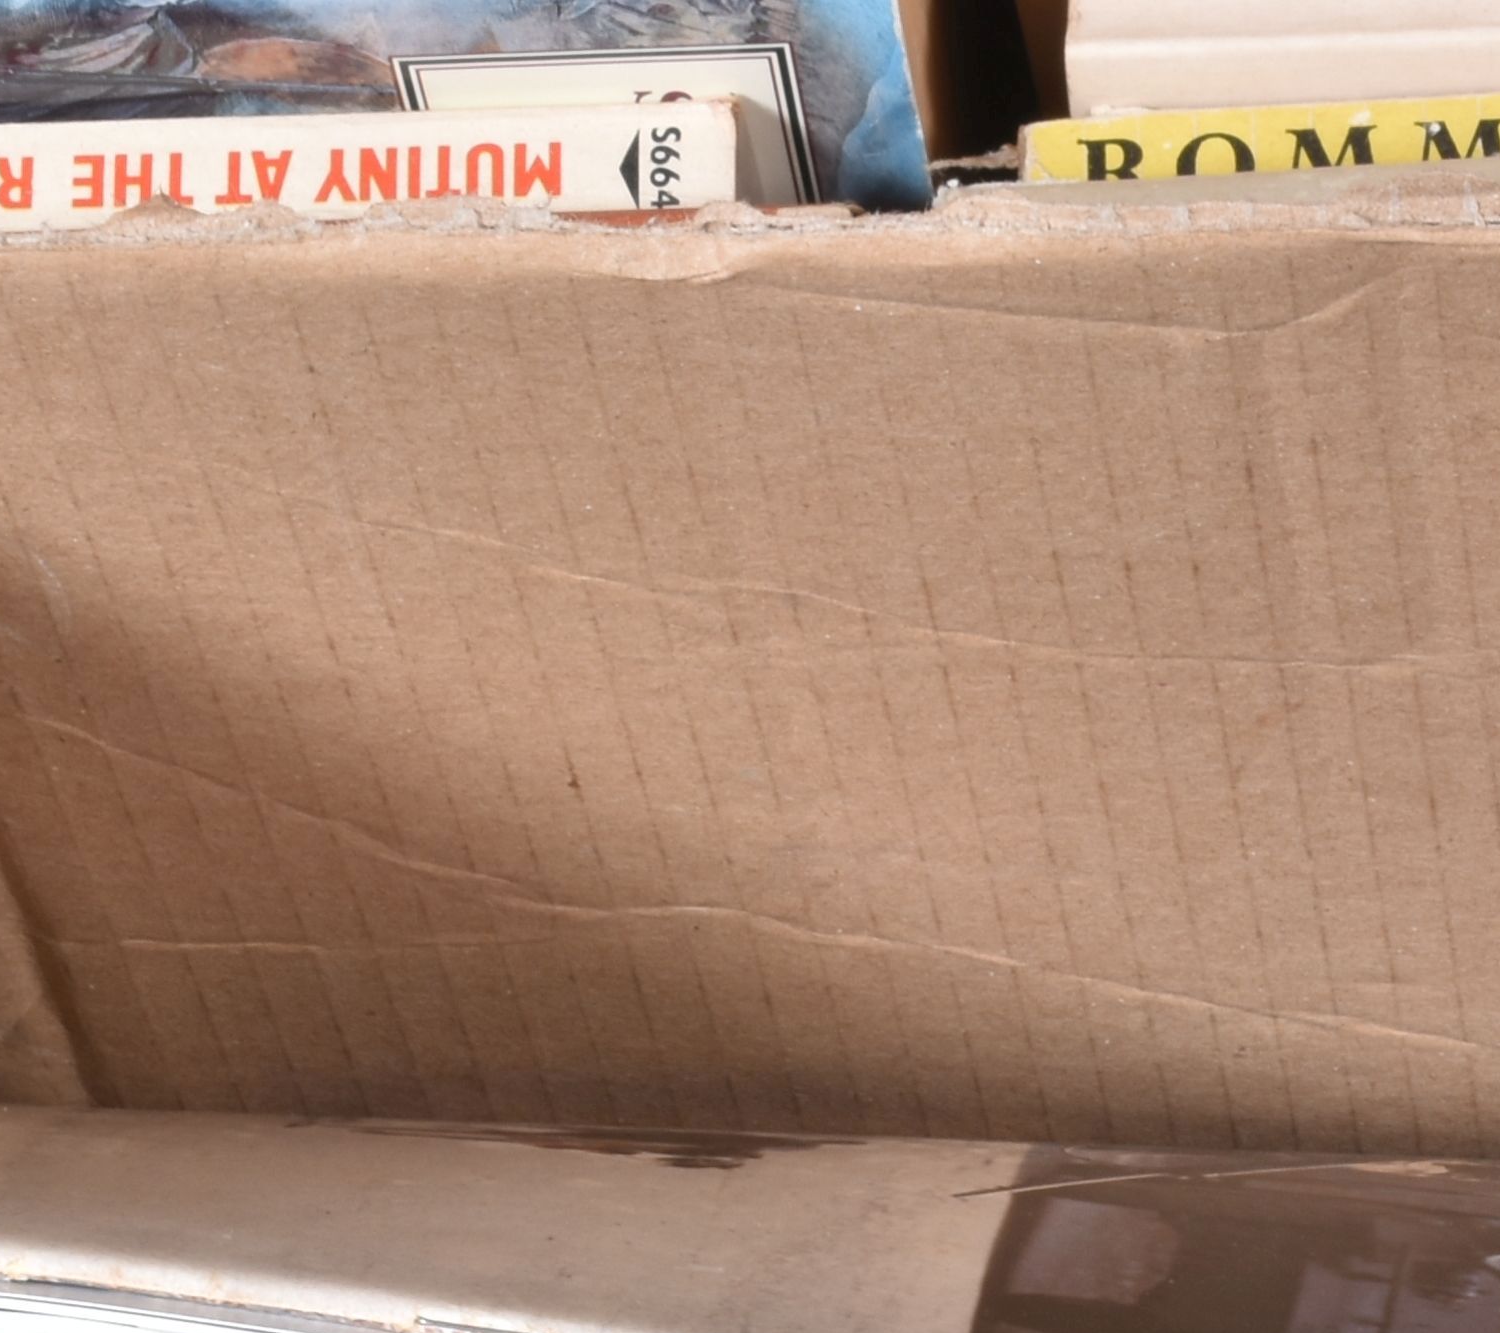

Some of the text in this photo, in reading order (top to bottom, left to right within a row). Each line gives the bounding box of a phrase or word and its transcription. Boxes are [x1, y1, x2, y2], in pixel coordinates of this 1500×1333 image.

[72, 152, 193, 209] THE
[215, 148, 293, 205] AT
[314, 141, 563, 203] MUTINY
[650, 126, 682, 208] S664
